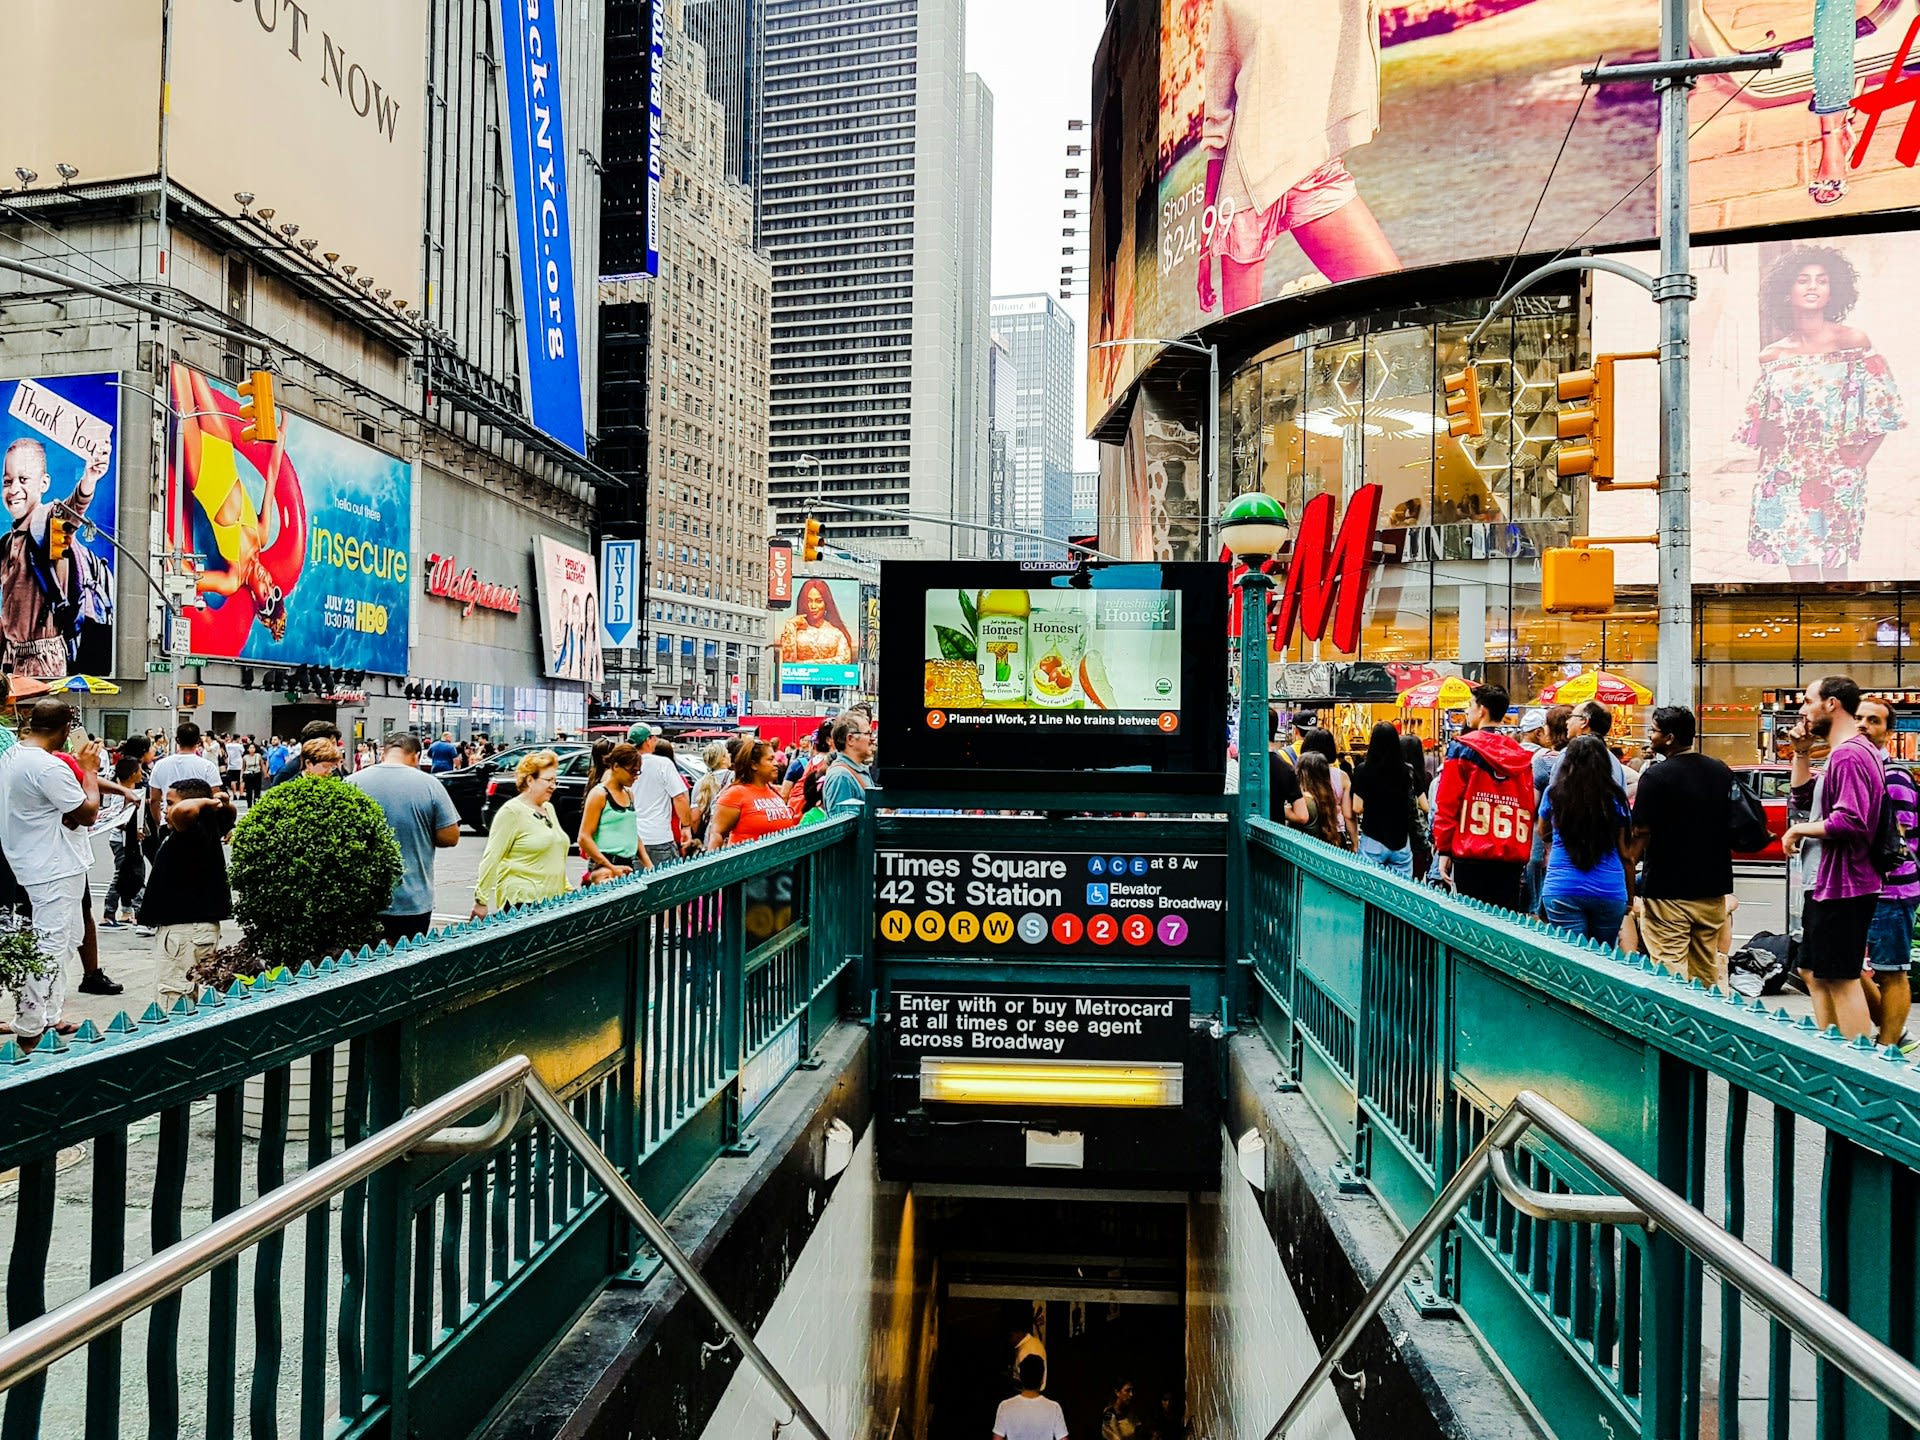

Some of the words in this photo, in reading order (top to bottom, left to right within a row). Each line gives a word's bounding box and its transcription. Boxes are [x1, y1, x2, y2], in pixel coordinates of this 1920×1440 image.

[233, 0, 308, 61] UT
[321, 32, 400, 143] NOW
[651, 52, 663, 109] BAR
[650, 112, 661, 176] DIVE
[1163, 183, 1204, 228] Shorts
[1163, 196, 1235, 277] $24.99
[18, 383, 64, 435] Thank
[71, 416, 97, 456] You
[992, 448, 1003, 505] TIMES
[353, 503, 363, 516] out
[365, 504, 381, 521] there
[311, 516, 408, 583] insecure
[1023, 561, 1076, 570] OUTFRONT
[428, 552, 521, 617] Walgreens
[614, 548, 625, 622] NYPD
[325, 595, 343, 611] JULY
[345, 598, 355, 614] 23
[1104, 599, 1167, 610] refreshingly
[1104, 608, 1170, 623] Honest
[324, 611, 342, 628] 10:30
[343, 614, 355, 630] PM
[356, 600, 388, 635] HBO
[1033, 623, 1080, 634] Honest
[982, 625, 1024, 636] Honest
[151, 663, 157, 672] W
[158, 663, 165, 672] 42
[692, 702, 712, 718] POLICE
[949, 714, 993, 725] Planned
[996, 714, 1027, 726] Work,
[1029, 715, 1037, 725] 2
[1039, 714, 1063, 725] Line
[1065, 715, 1081, 725] No
[1084, 715, 1115, 726] trains
[1460, 799, 1532, 844] 1966
[880, 852, 960, 879] Times
[971, 852, 1067, 883] Square
[1092, 860, 1102, 871] A
[1112, 860, 1123, 872] C
[1135, 861, 1143, 872] E
[1150, 858, 1164, 869] at
[1168, 857, 1178, 869] 8
[1182, 857, 1198, 870] Av
[880, 881, 915, 904] 42
[925, 882, 955, 906] St
[966, 883, 1062, 907] Station
[1110, 883, 1162, 896] Elevator
[1110, 898, 1154, 909] across
[1158, 897, 1222, 912] Broadway
[889, 917, 903, 934] N
[922, 916, 938, 934] Q
[957, 918, 971, 935] R
[988, 918, 1009, 936] W
[1025, 920, 1041, 938] S
[1096, 920, 1109, 938] 2
[1131, 921, 1145, 939] 3
[1166, 922, 1180, 940] 7
[900, 995, 950, 1012] Enter
[958, 996, 996, 1013] with
[1005, 1001, 1024, 1013] or
[1032, 998, 1067, 1019] buy
[1075, 1000, 1173, 1017] Metrocard
[900, 1015, 918, 1029] at
[927, 1014, 948, 1030] all
[956, 1015, 1008, 1032] times
[1016, 1020, 1036, 1033] or
[1044, 1020, 1079, 1033] see
[1088, 1019, 1142, 1037] agent
[900, 1034, 963, 1048] across
[971, 1033, 1065, 1053] Broadway
